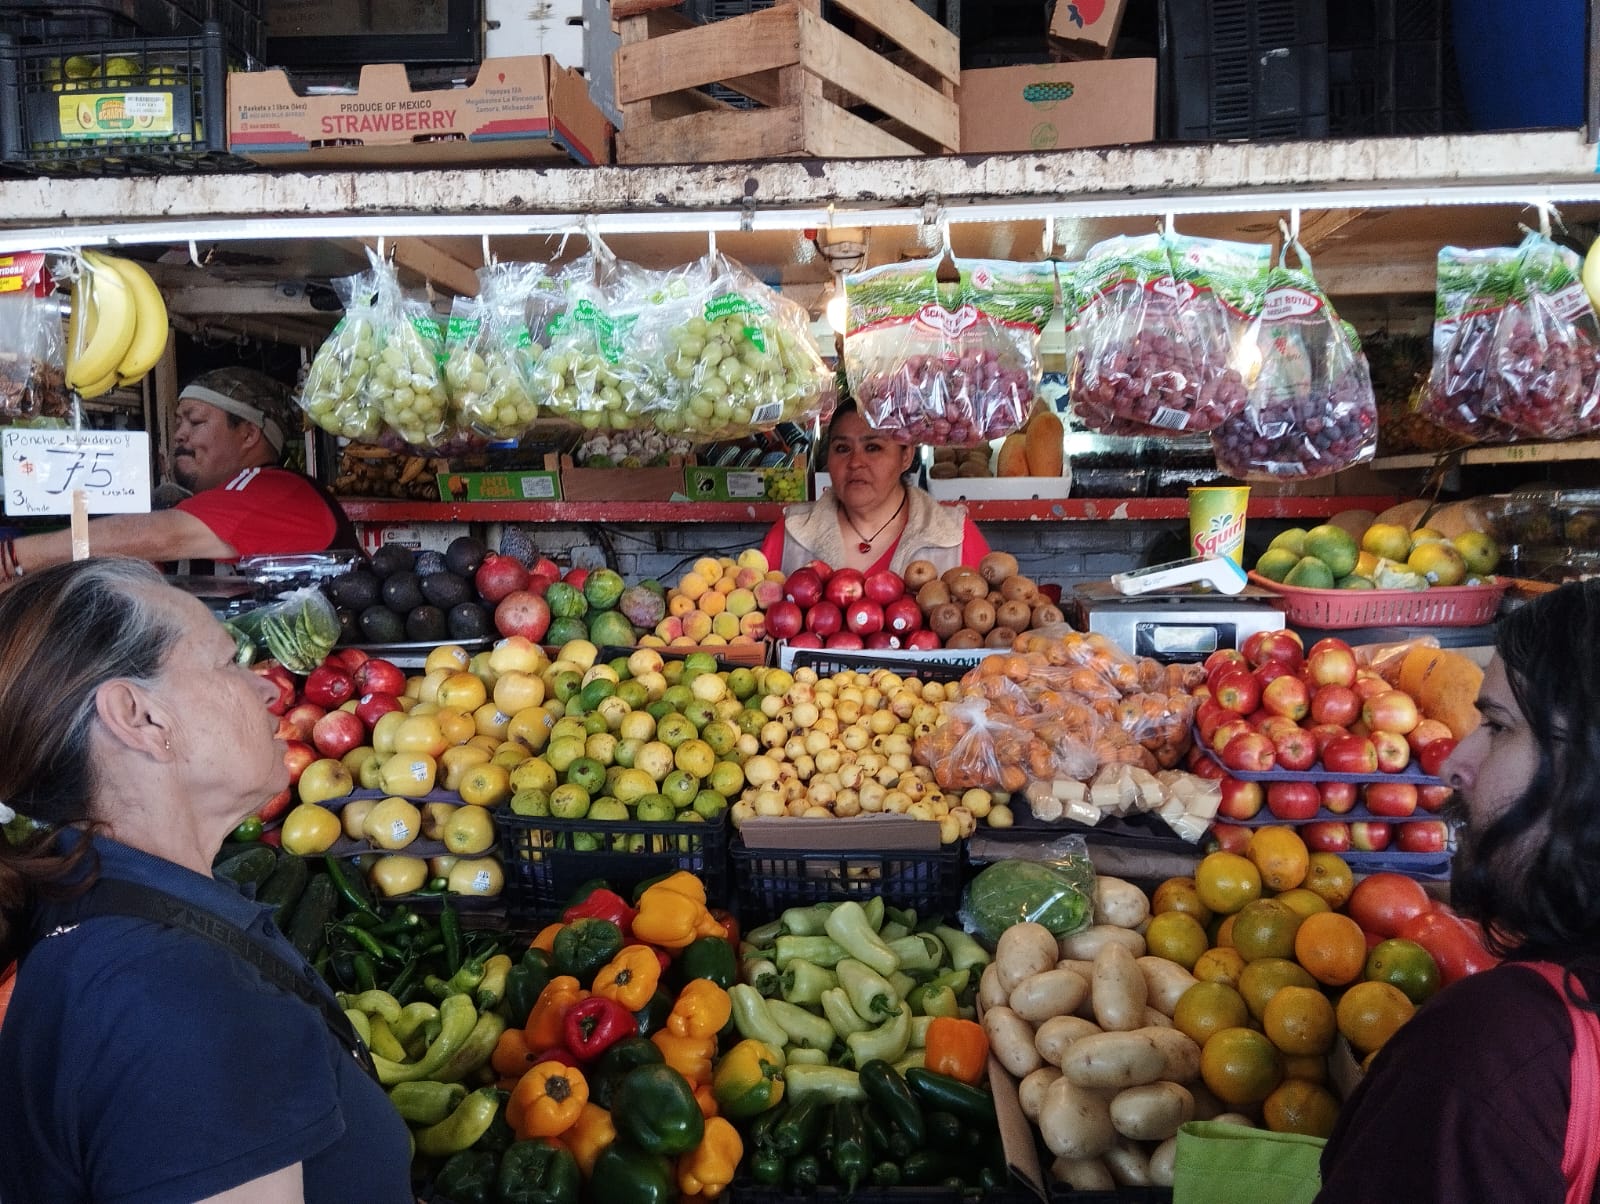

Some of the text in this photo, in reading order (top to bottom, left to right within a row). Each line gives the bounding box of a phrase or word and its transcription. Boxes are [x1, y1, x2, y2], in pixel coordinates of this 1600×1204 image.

[340, 100, 432, 112] PRODUCE OF MEXICO
[321, 110, 457, 134] STRAWBERRY
[1285, 295, 1313, 307] ROYAL
[22, 449, 114, 494] $ 75
[1194, 512, 1245, 556] Squirt
